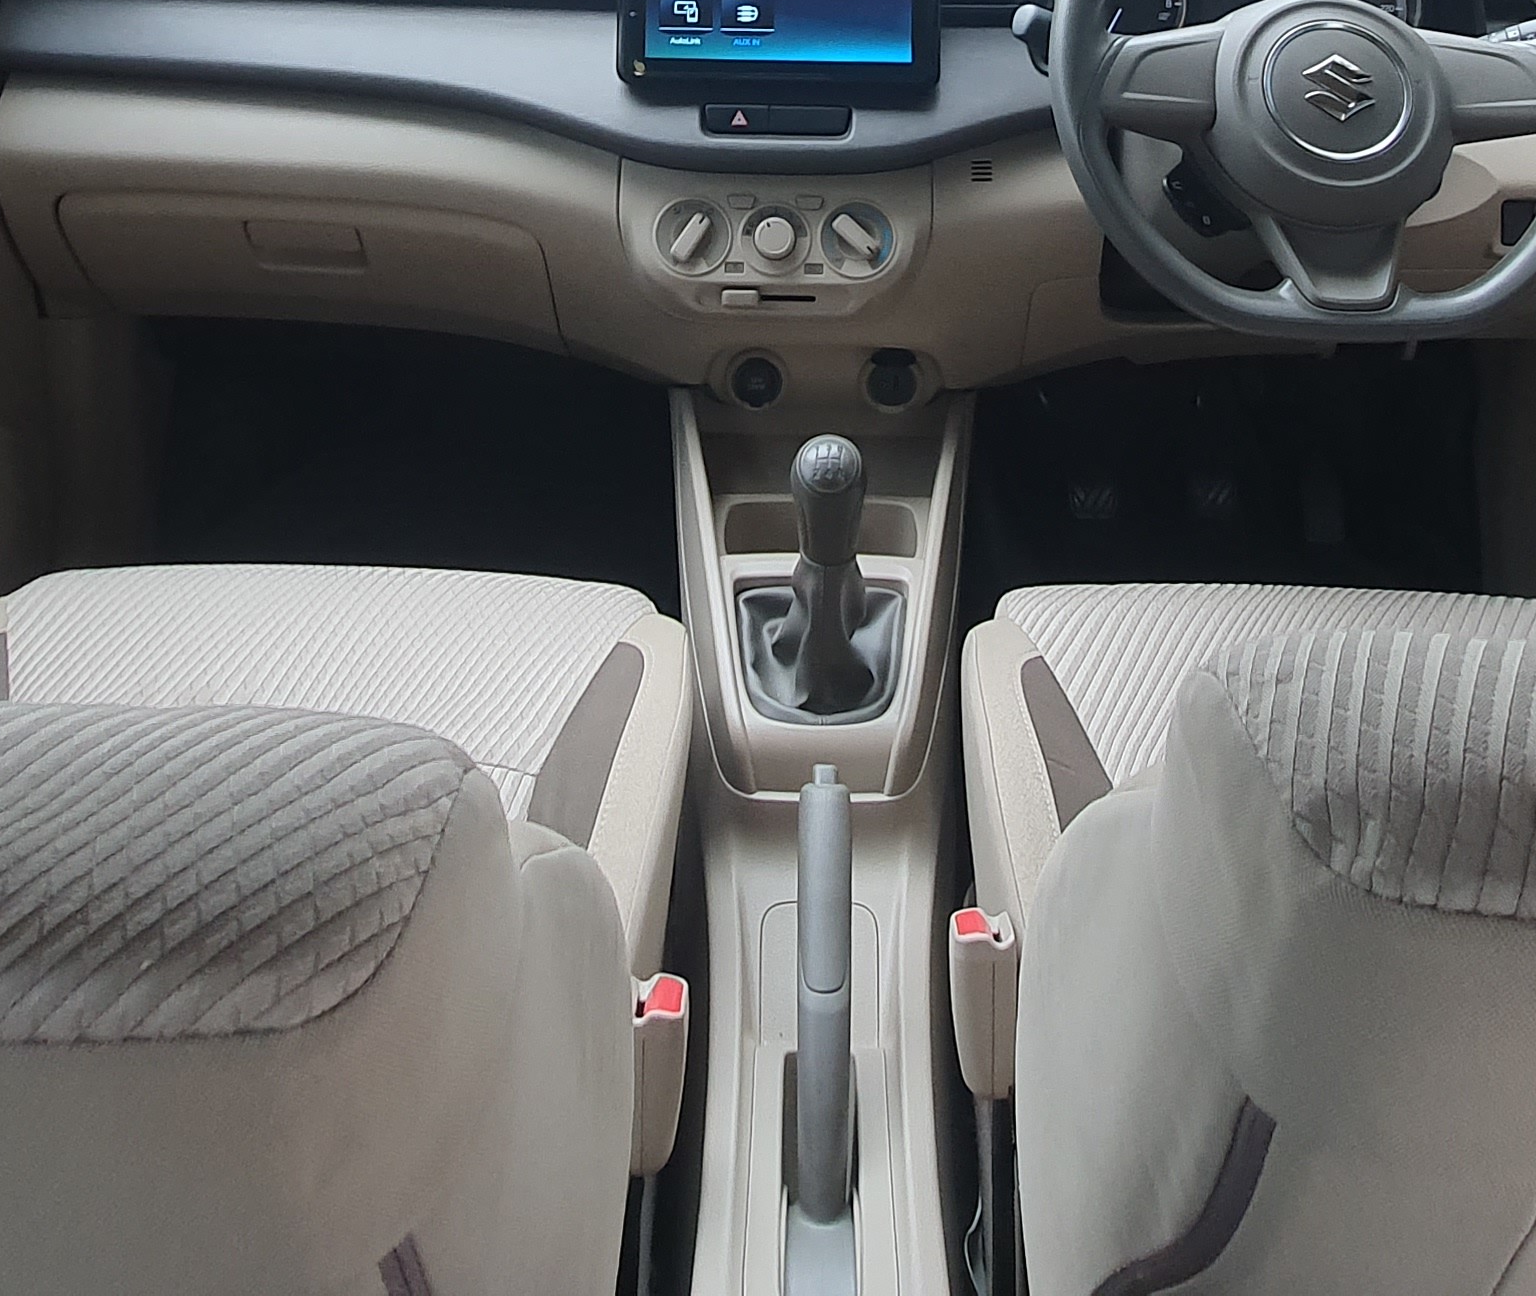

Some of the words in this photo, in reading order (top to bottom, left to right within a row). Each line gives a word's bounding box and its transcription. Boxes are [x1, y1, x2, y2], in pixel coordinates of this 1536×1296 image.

[1165, 0, 1172, 8] 8
[733, 38, 751, 46] AUX
[751, 38, 761, 46] IN
